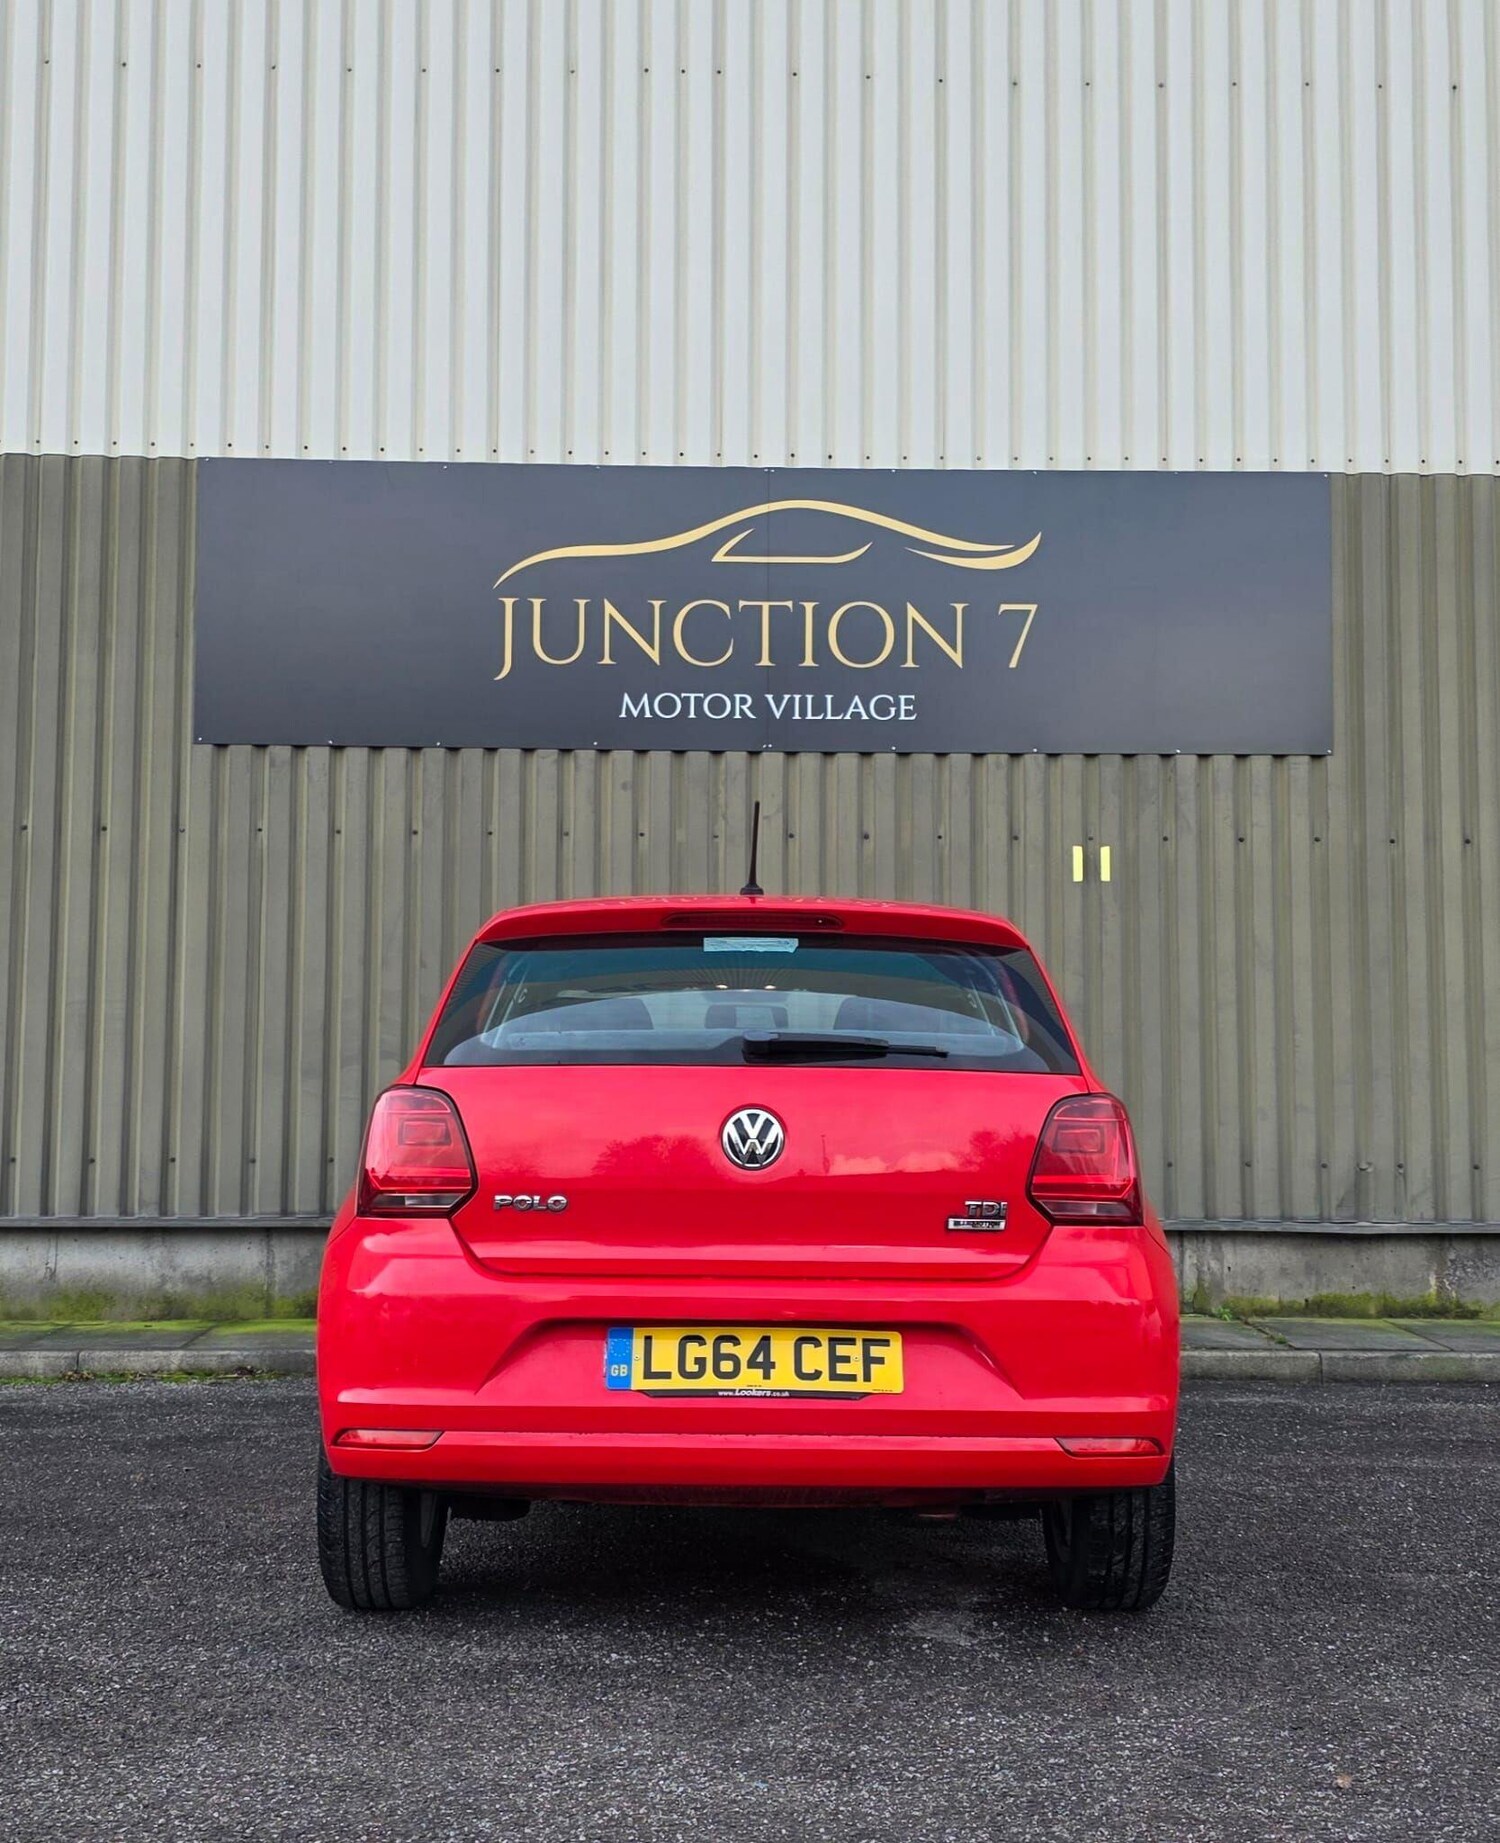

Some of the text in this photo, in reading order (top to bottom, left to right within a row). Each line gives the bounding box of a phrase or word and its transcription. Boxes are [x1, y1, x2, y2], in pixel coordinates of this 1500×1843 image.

[493, 597, 1038, 681] JUNCTION 7
[618, 692, 918, 721] MOTOR VILLAGE
[494, 1195, 566, 1211] POLO
[965, 1201, 1008, 1216] TDI
[643, 1334, 891, 1382] LG64 CEF
[611, 1364, 628, 1376] GB
